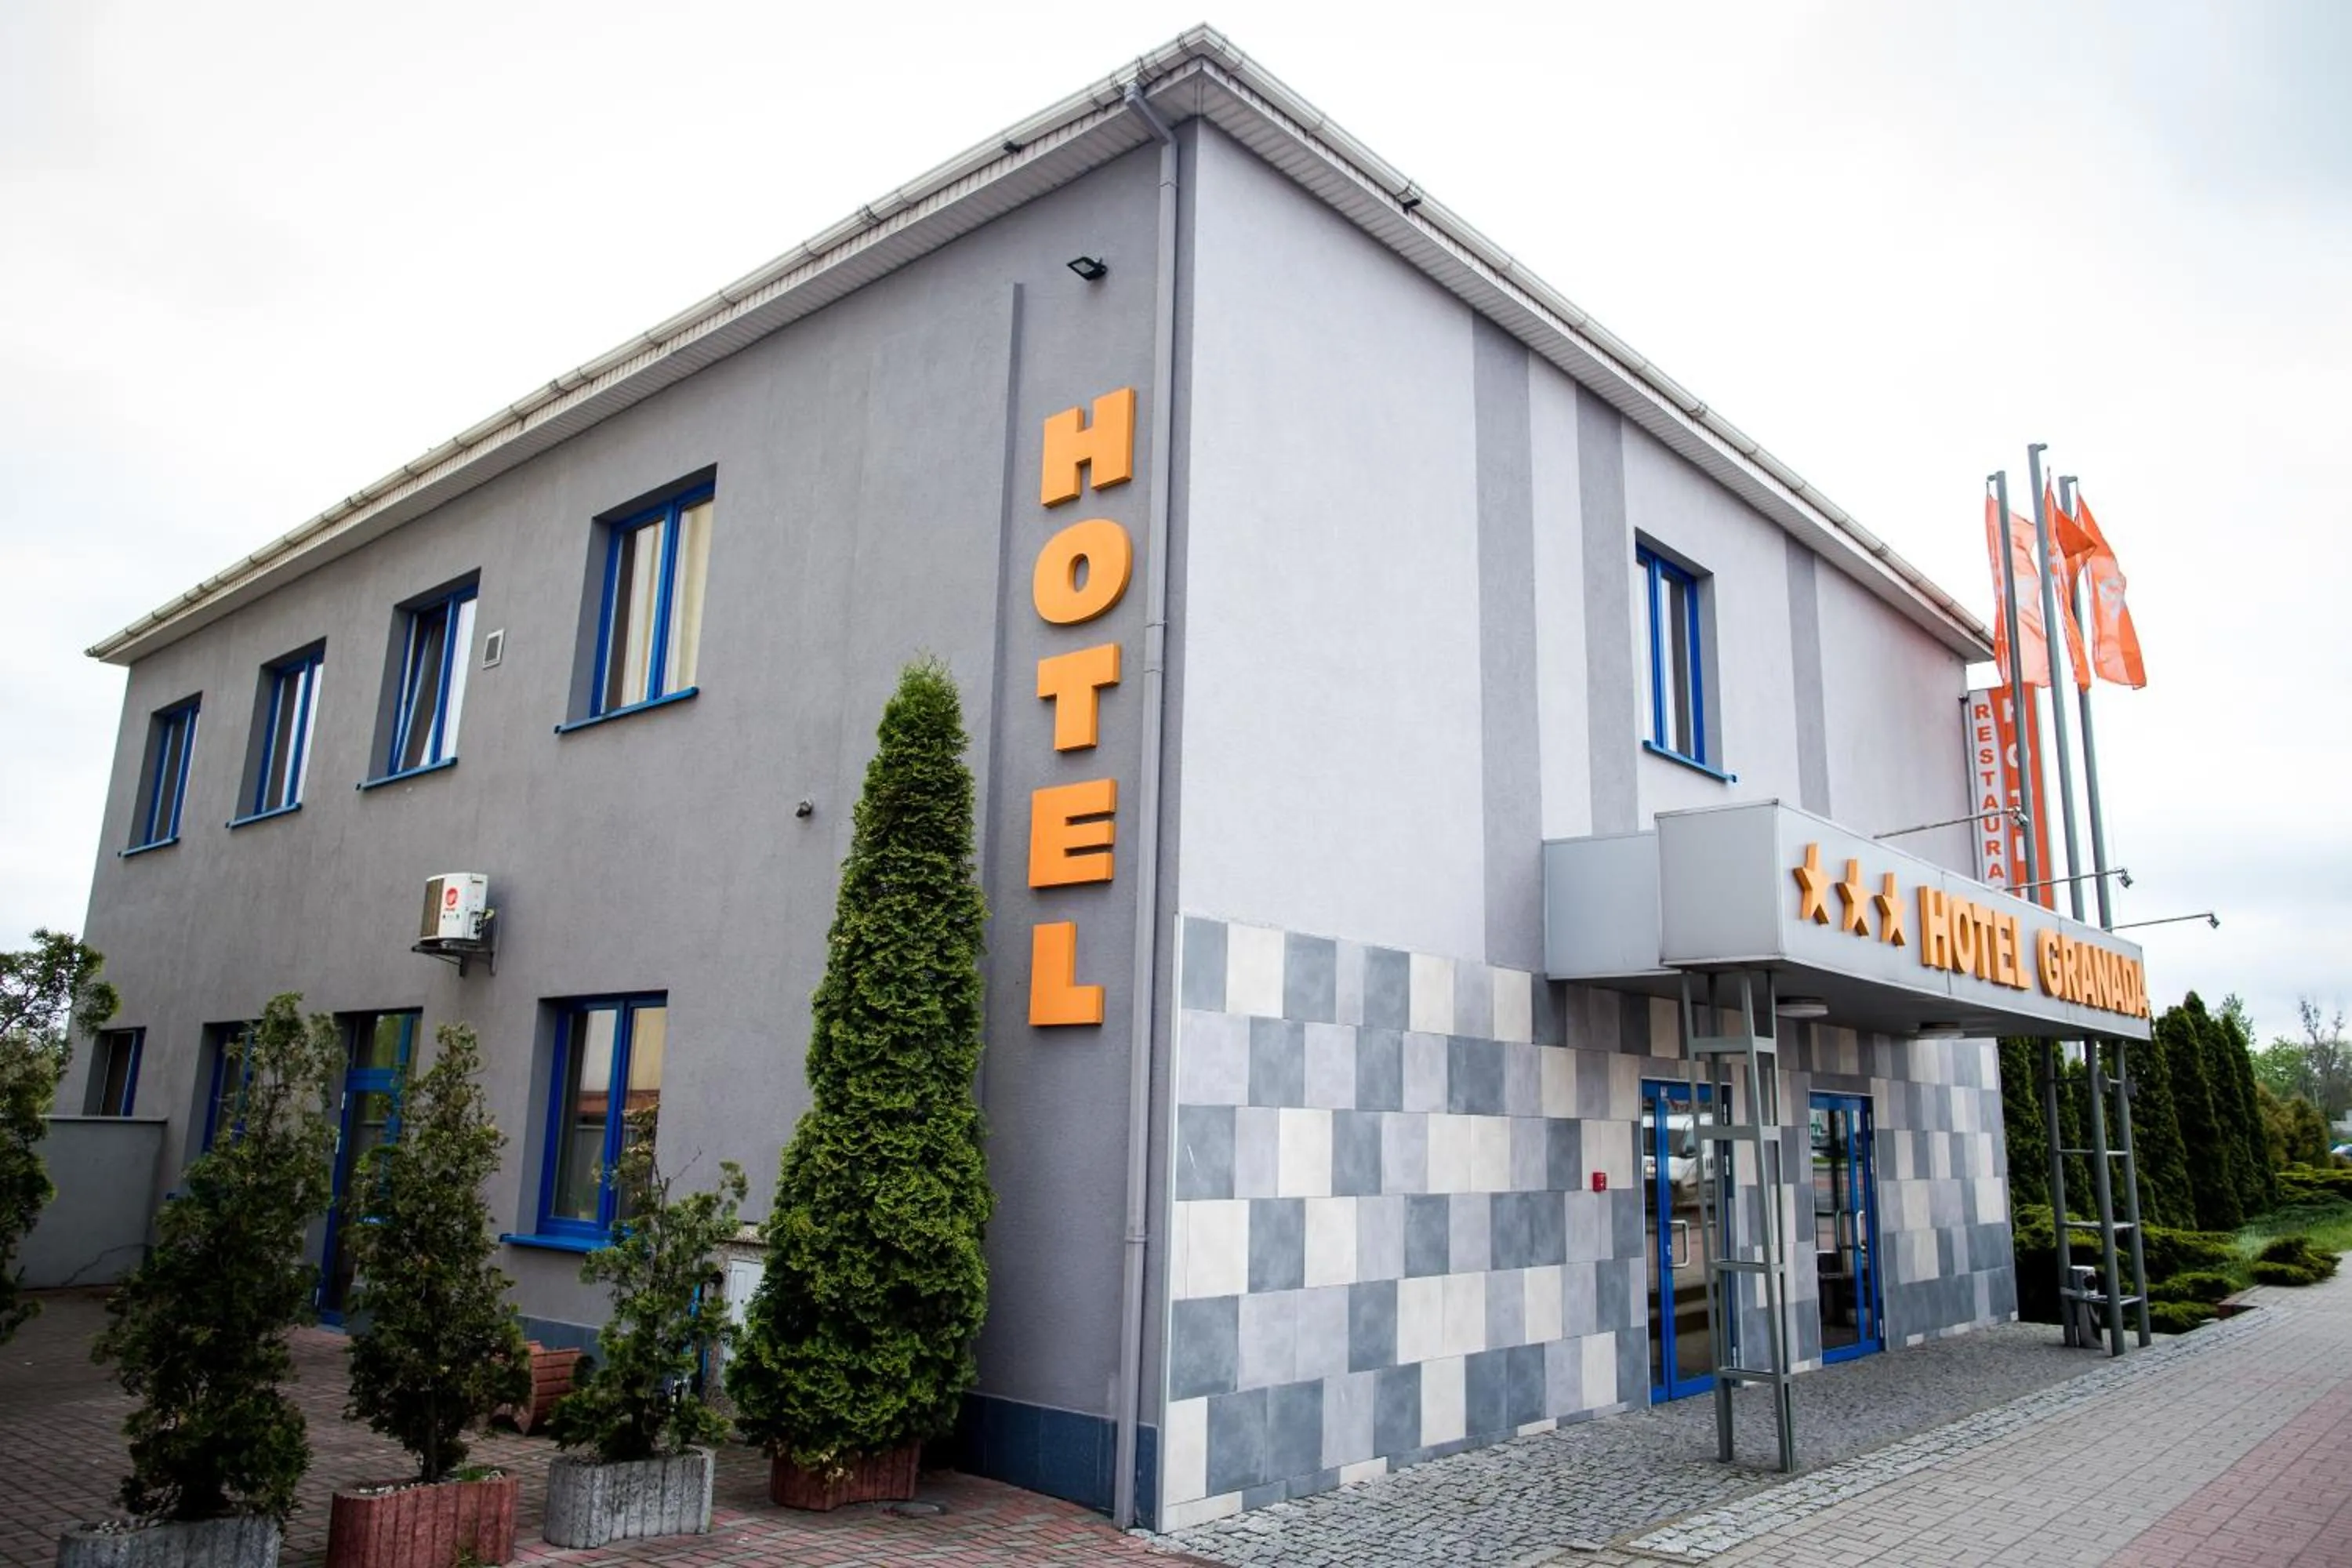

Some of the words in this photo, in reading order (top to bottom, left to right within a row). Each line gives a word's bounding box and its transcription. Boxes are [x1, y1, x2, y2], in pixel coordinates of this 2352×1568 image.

[1029, 387, 1135, 1026] HOTEL
[1974, 703, 2005, 887] RESTAURA
[1918, 885, 2031, 989] HOTEL
[2036, 927, 2150, 1018] GRANADA
